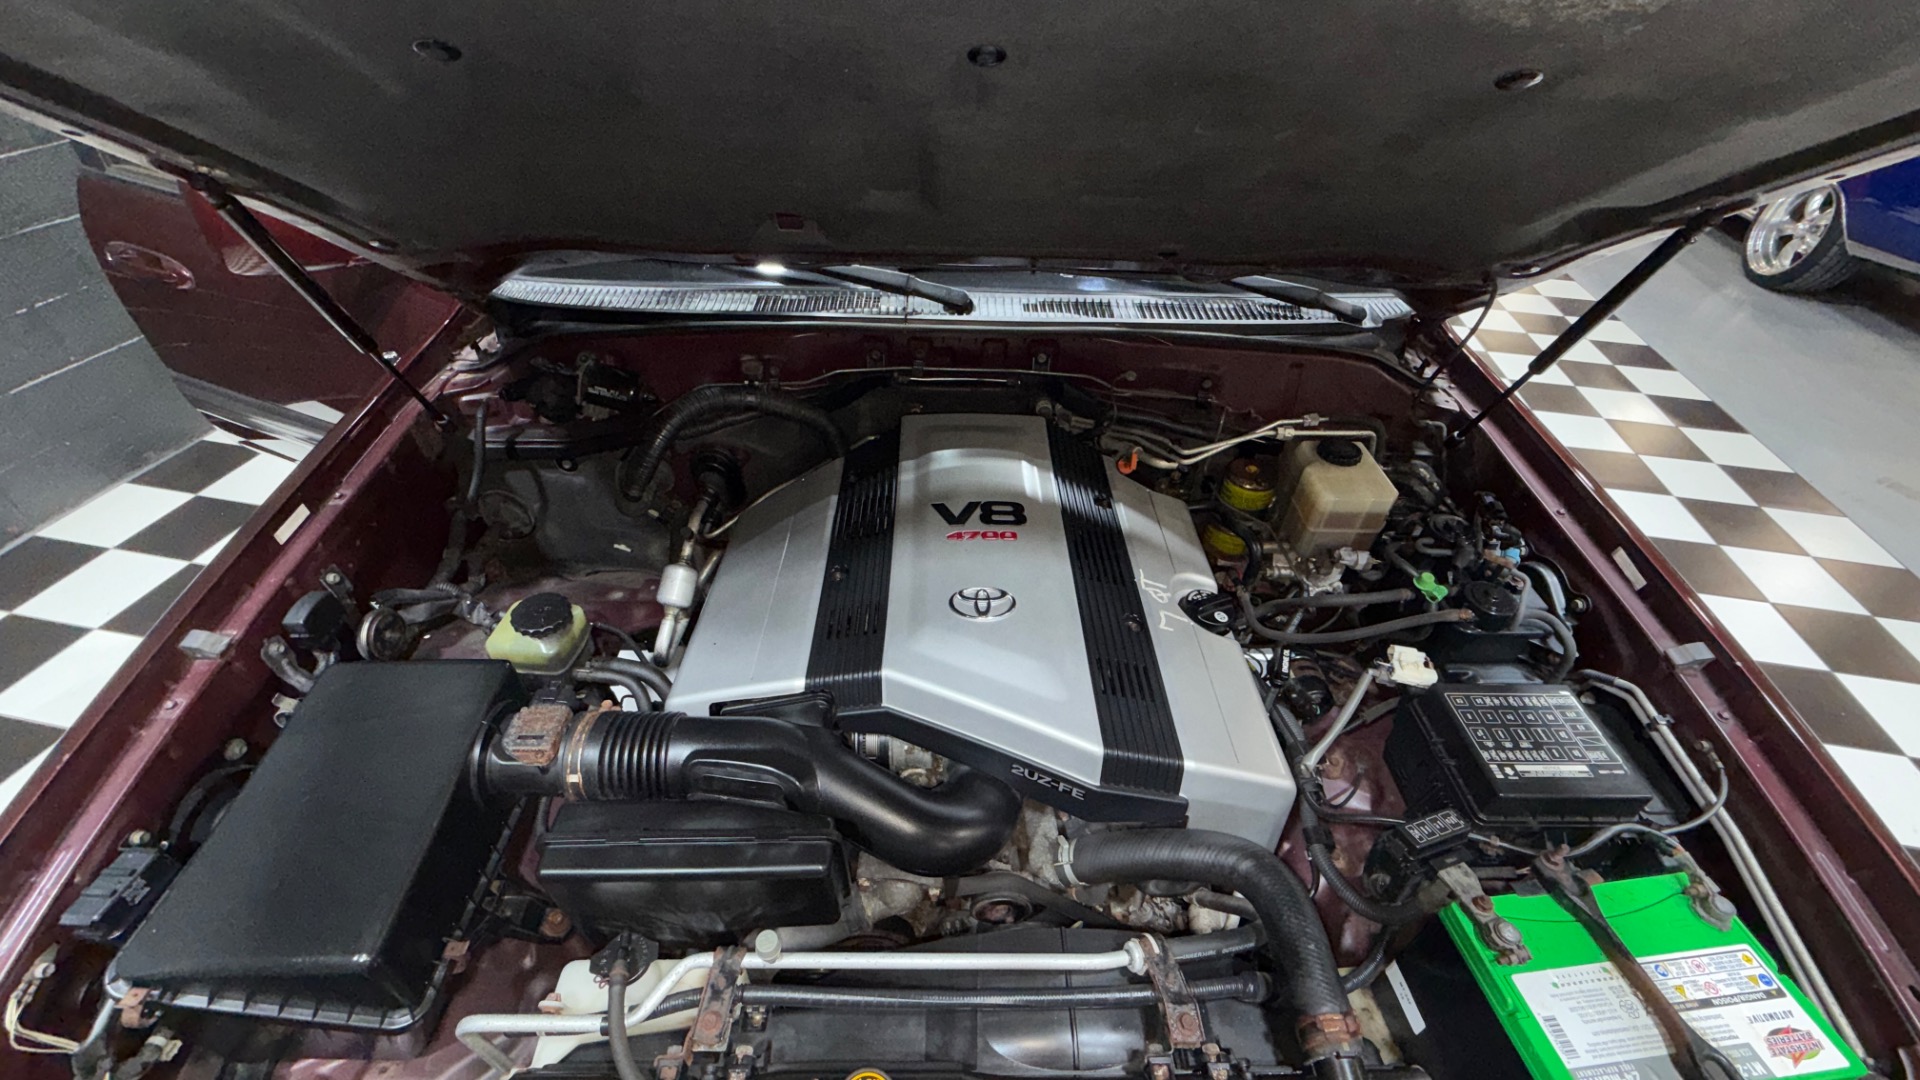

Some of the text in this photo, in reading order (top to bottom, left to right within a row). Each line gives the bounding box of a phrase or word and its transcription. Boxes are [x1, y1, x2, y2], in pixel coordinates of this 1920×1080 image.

[931, 501, 1028, 526] V8
[946, 530, 1018, 541] 4700
[1010, 764, 1086, 801] 2UZ-FE
[1711, 991, 1767, 1006] DANGER/POISON
[1746, 1009, 1795, 1024] AUTOMOTIVE
[1766, 1031, 1814, 1046] BATTERIES
[1768, 1040, 1825, 1058] INTERSTATE
[1735, 1061, 1768, 1077] MT-2
